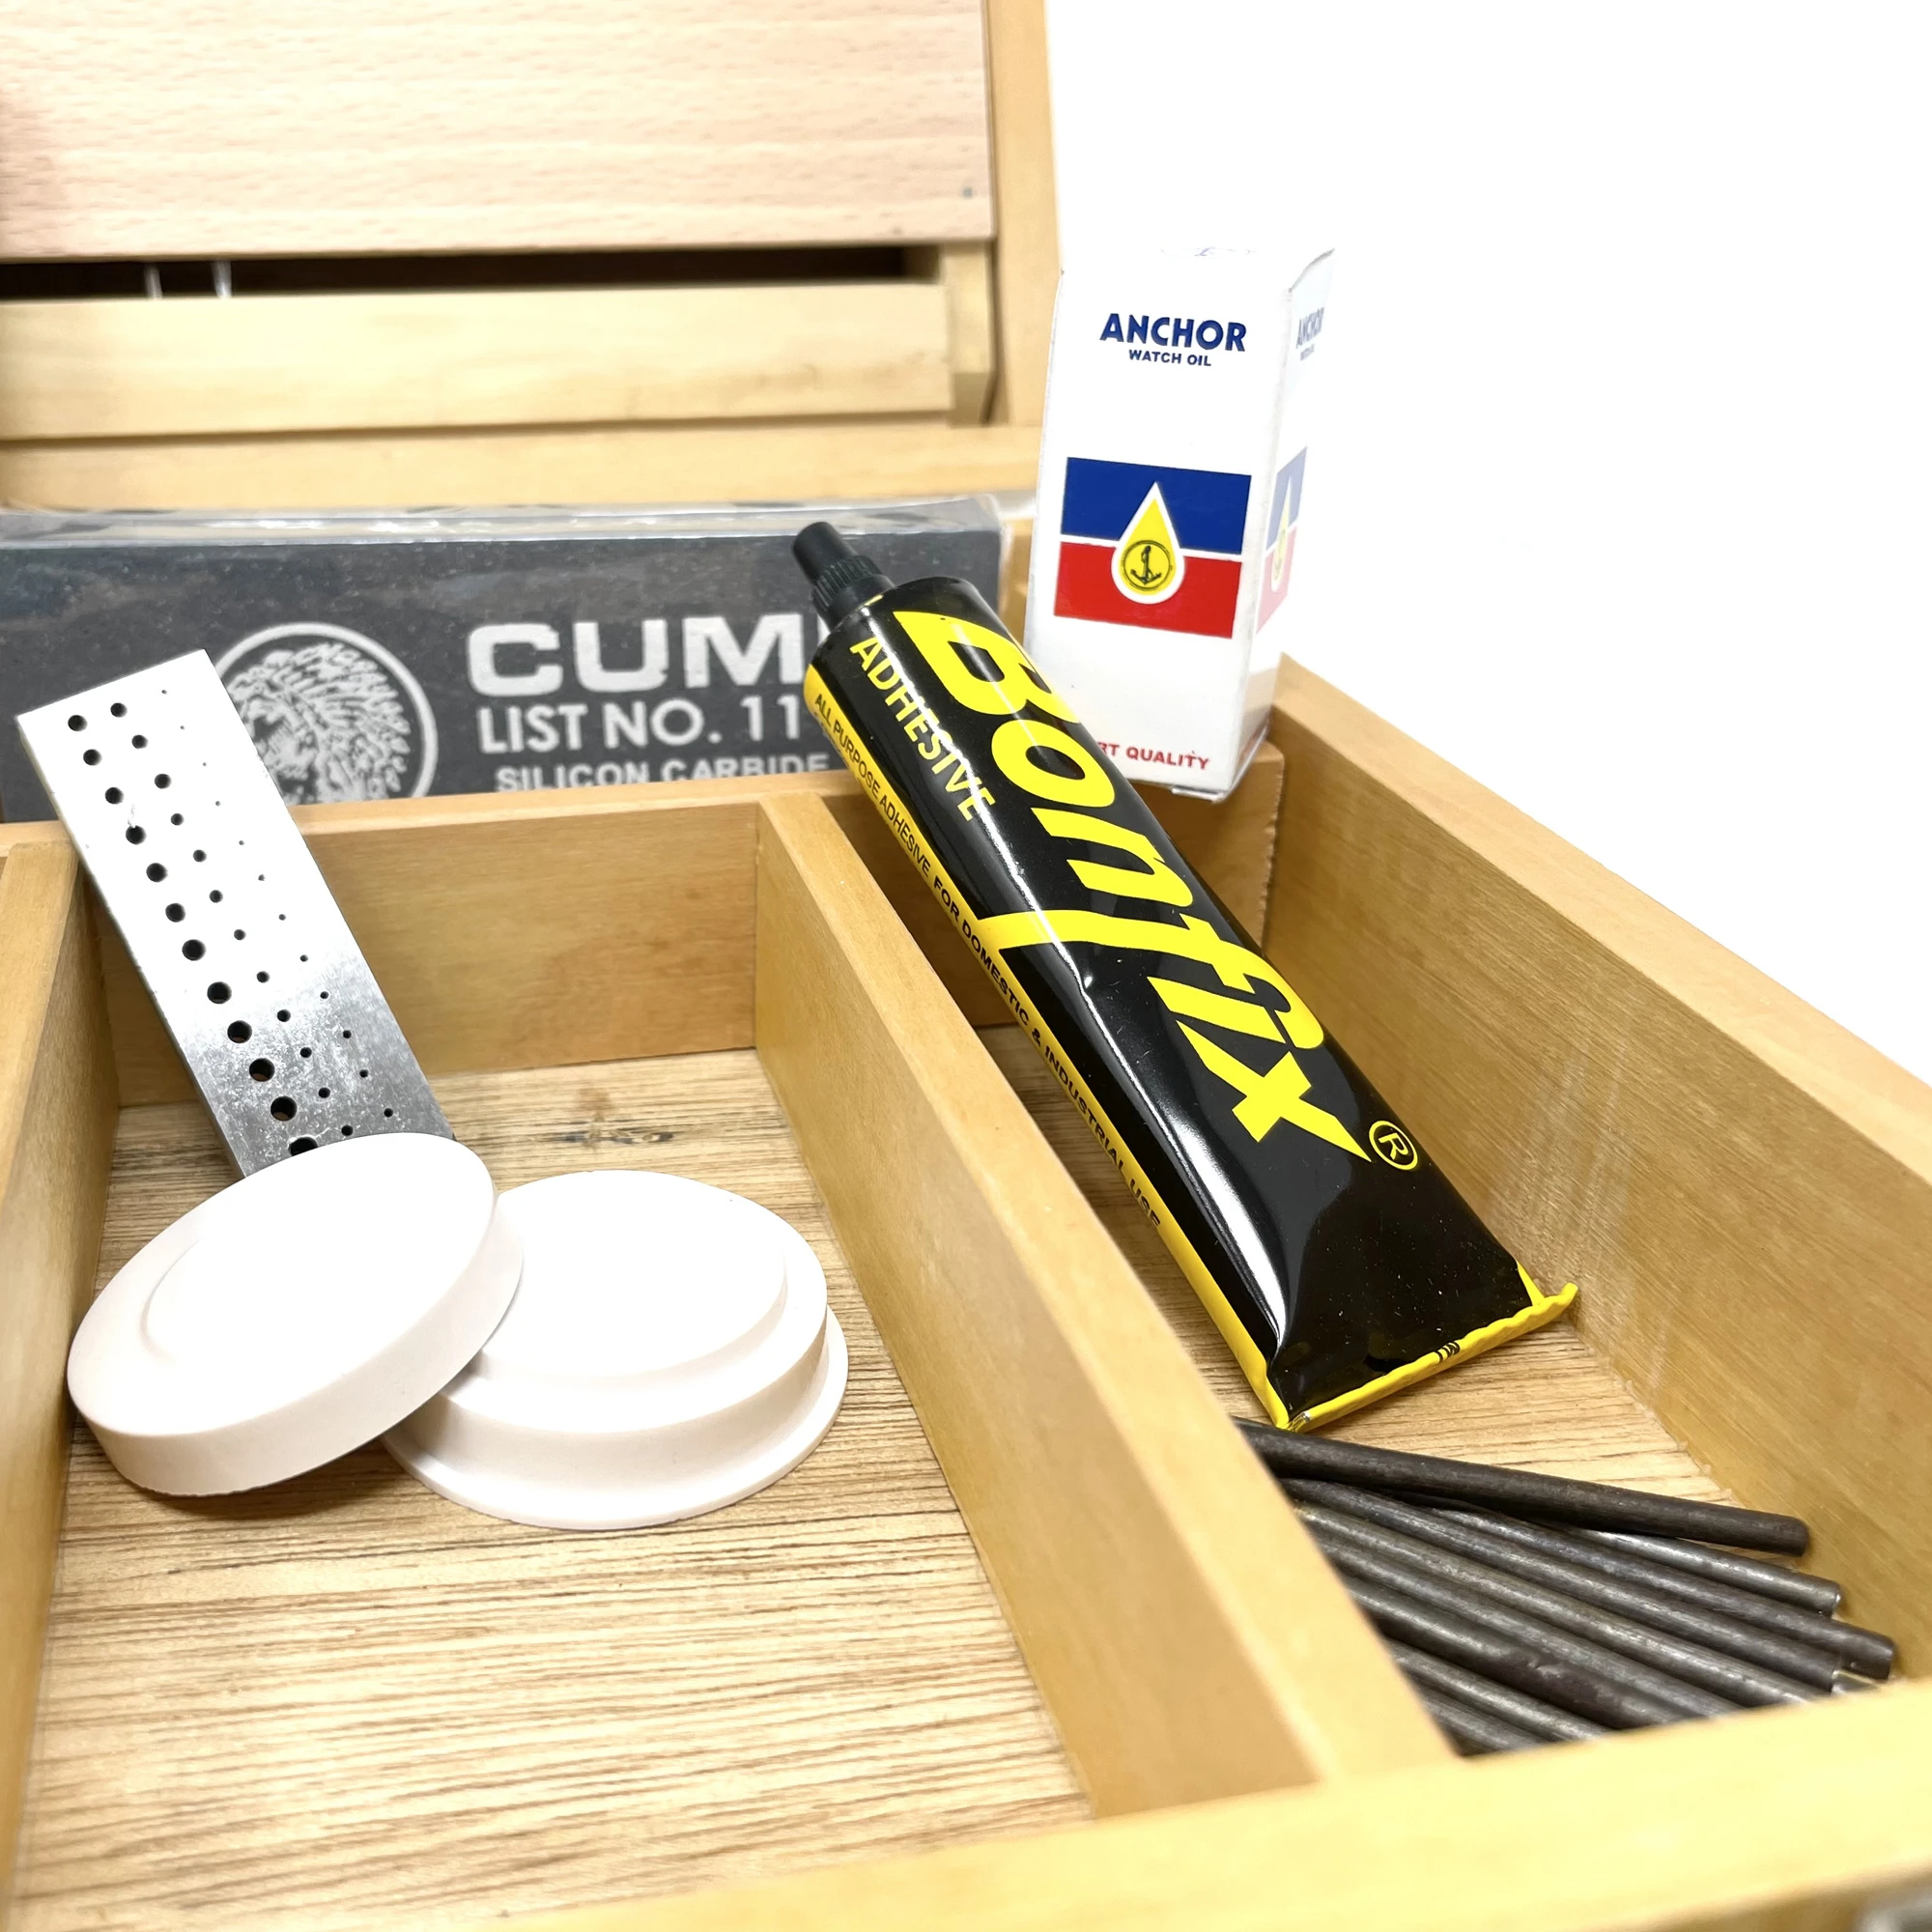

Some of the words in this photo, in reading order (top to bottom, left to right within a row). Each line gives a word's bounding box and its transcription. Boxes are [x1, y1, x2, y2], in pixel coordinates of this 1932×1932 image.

[1099, 312, 1247, 352] ANCHOR
[1128, 349, 1181, 364] WATCH
[1186, 354, 1211, 366] OIL
[468, 612, 831, 697] CUM
[477, 704, 587, 753] LIST
[602, 697, 722, 750] NO.
[849, 635, 996, 821] ADHESIVE
[496, 761, 649, 793] SILICON
[1125, 746, 1209, 770] QUALITY
[893, 611, 1372, 1162] Bonfix
[815, 694, 832, 727] ALL
[833, 719, 881, 800] PURPOSE
[879, 795, 931, 877] ADHESIVE
[933, 875, 960, 923] FOR
[961, 919, 1030, 1026] DOMESTIC
[1031, 1028, 1042, 1047] &
[1044, 1045, 1124, 1178] INDUSTRIAL
[1129, 1178, 1161, 1227] USE
